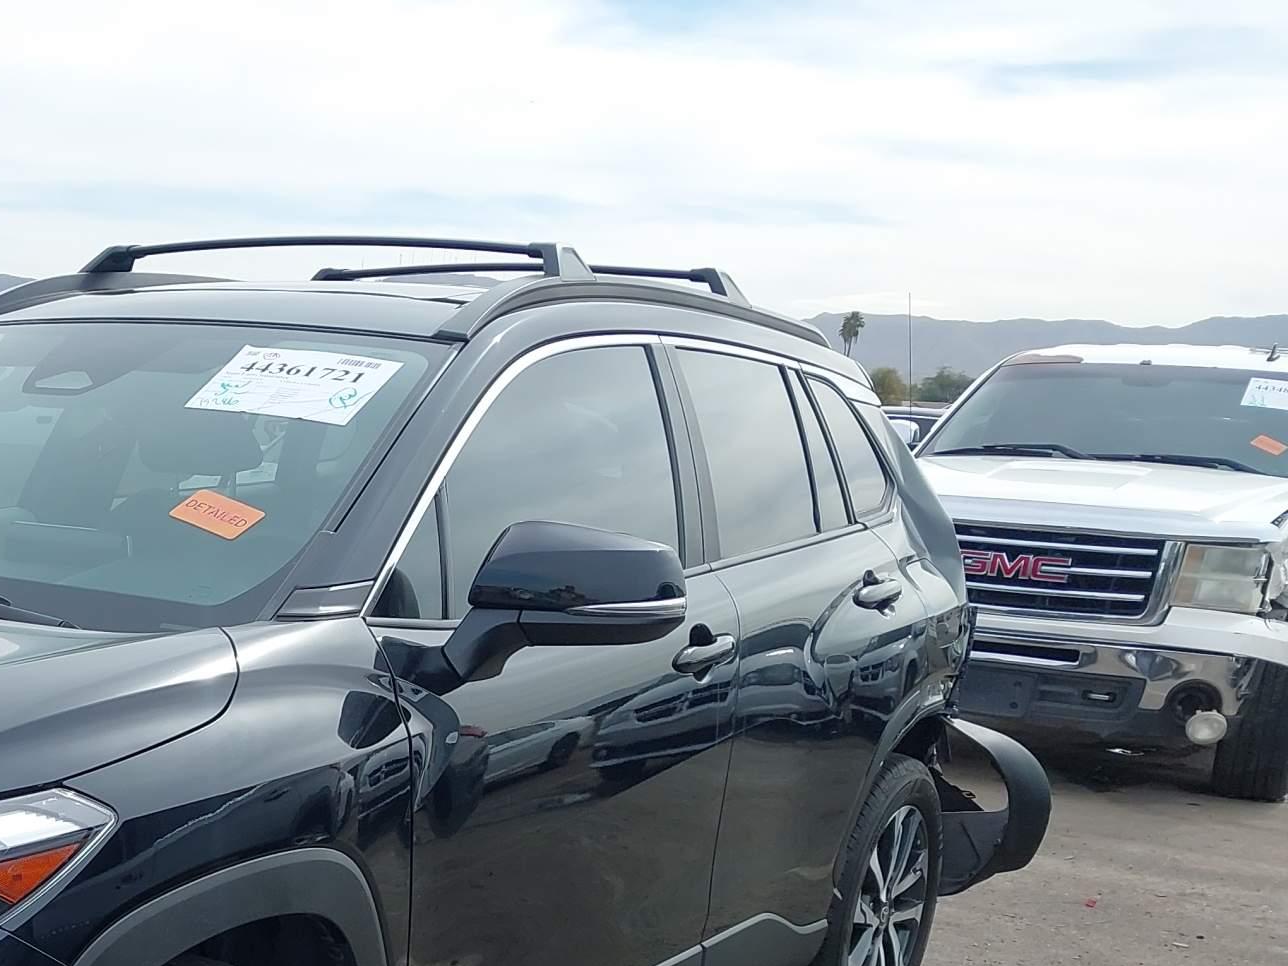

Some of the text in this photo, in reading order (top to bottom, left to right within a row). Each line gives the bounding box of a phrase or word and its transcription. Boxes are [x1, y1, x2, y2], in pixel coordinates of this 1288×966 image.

[240, 361, 366, 384] 44361721
[185, 499, 248, 528] DETAILED
[960, 549, 1072, 583] GMC
